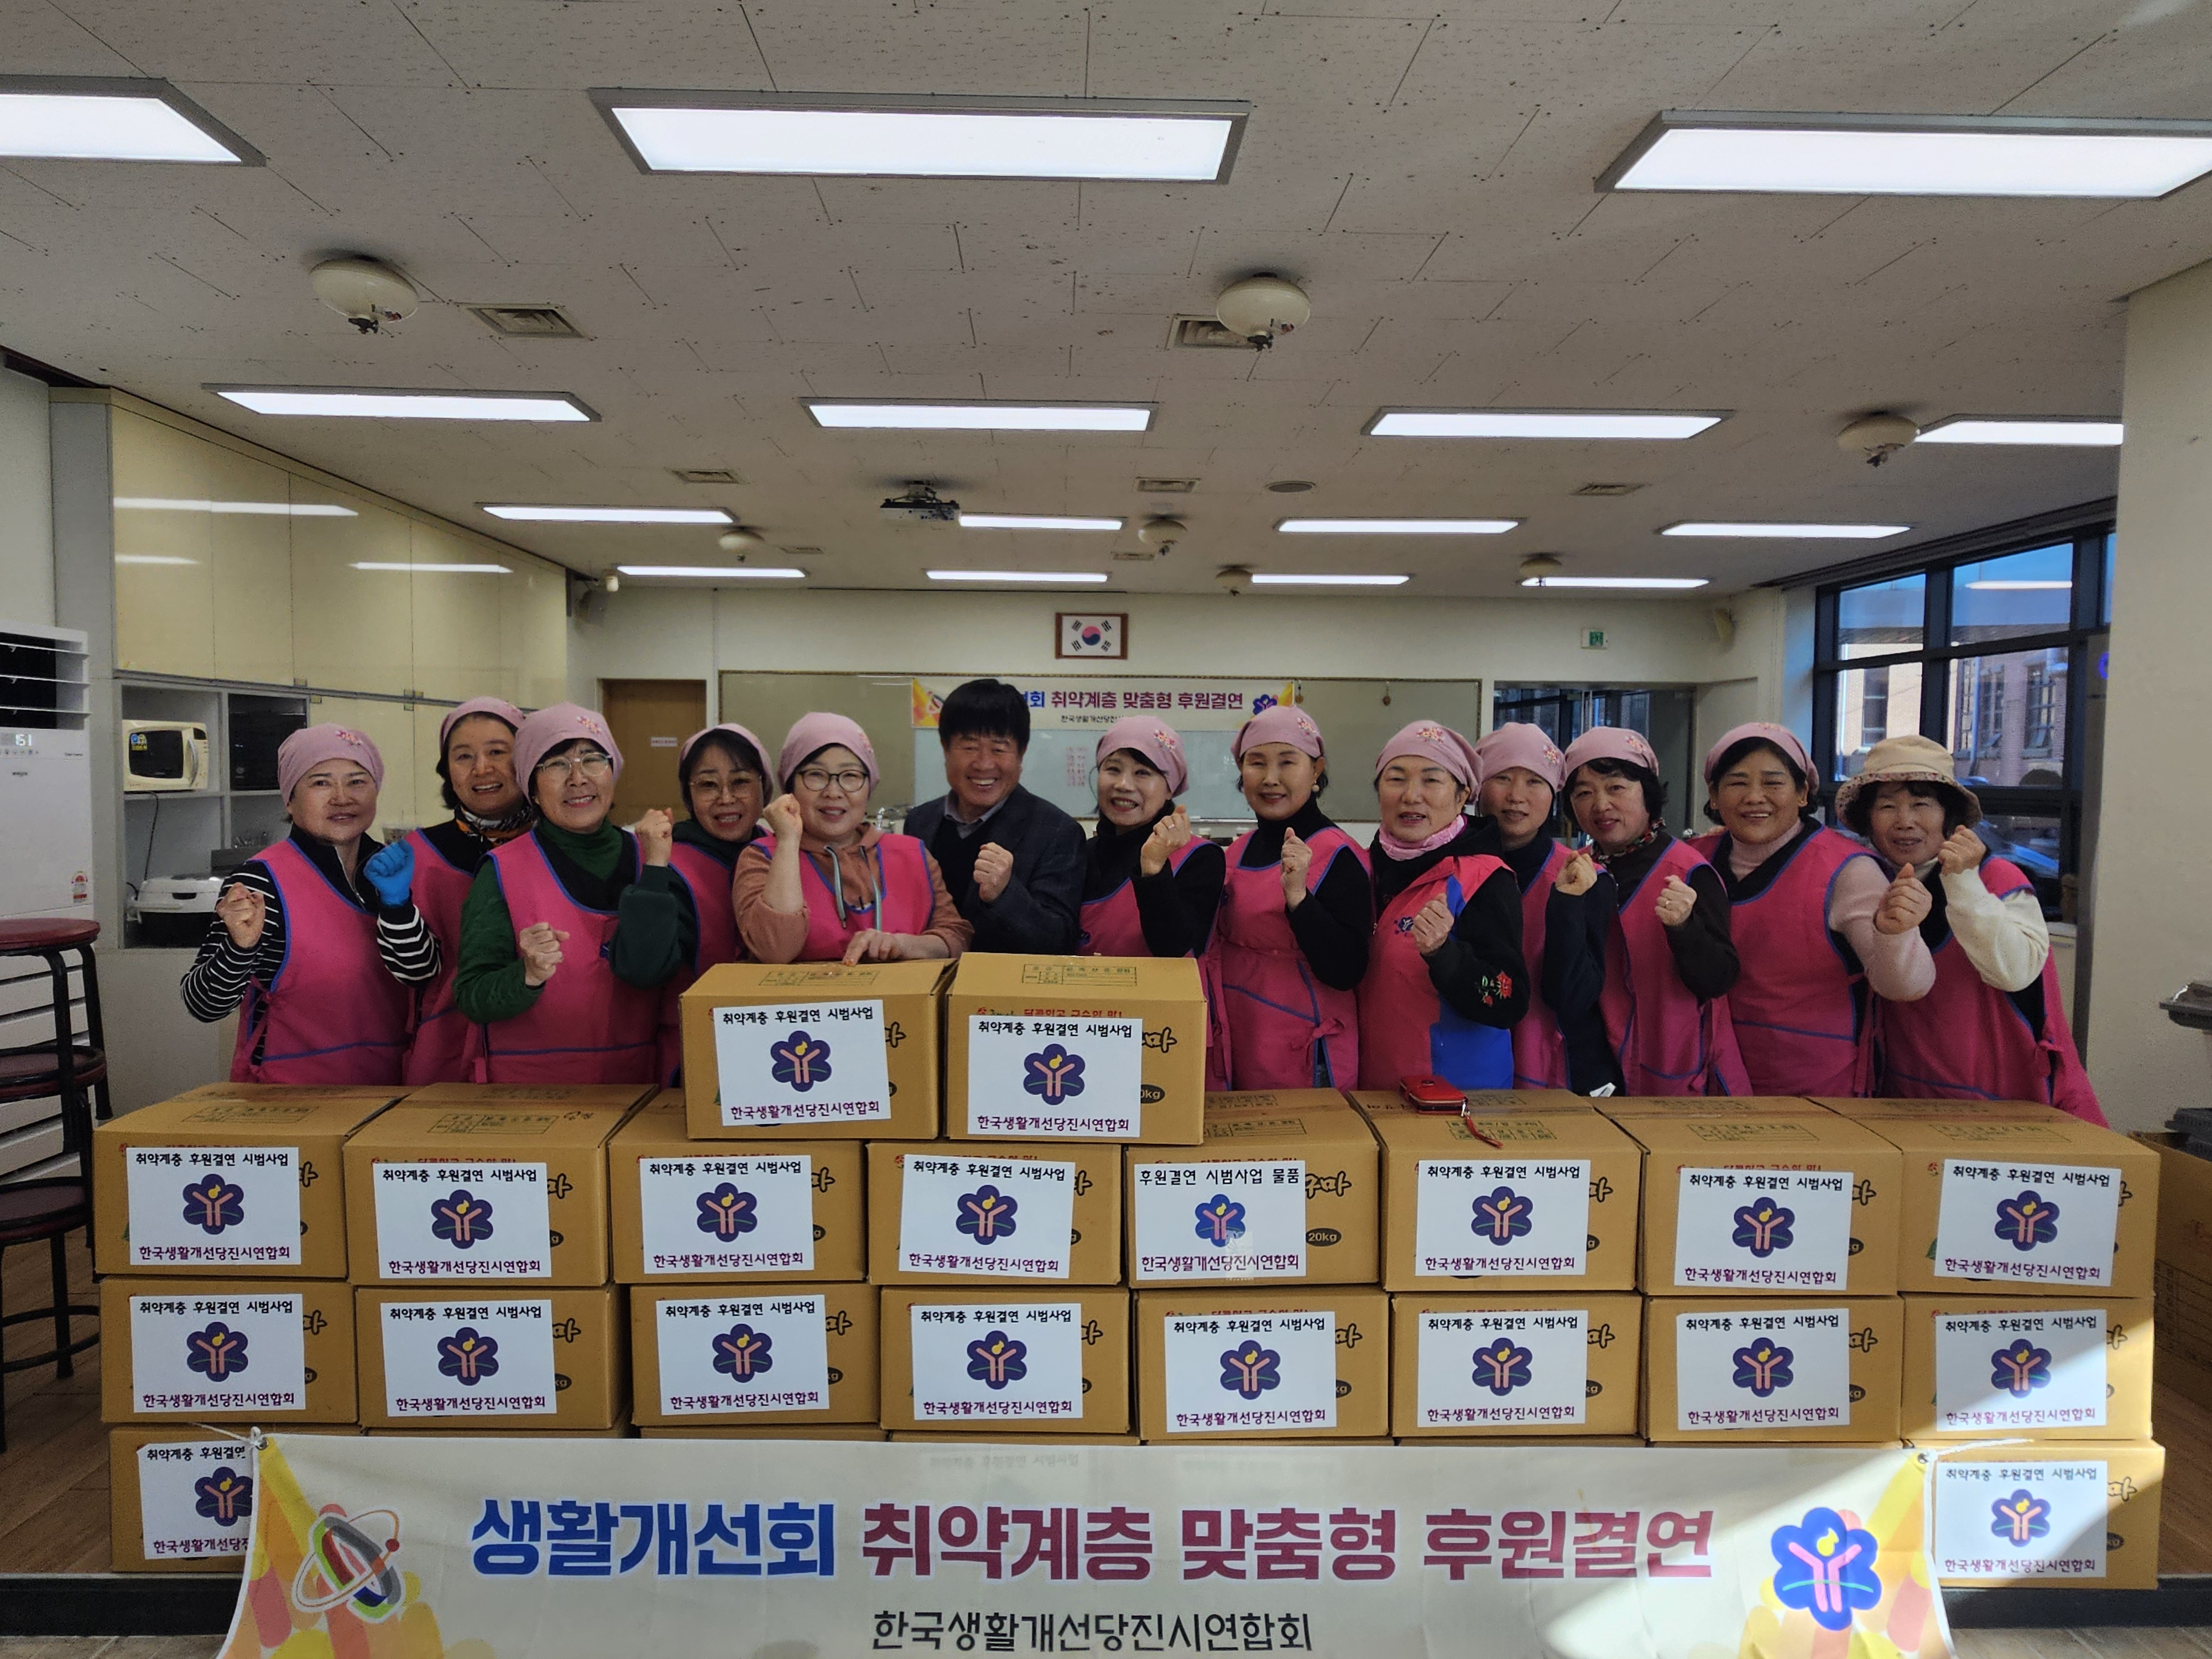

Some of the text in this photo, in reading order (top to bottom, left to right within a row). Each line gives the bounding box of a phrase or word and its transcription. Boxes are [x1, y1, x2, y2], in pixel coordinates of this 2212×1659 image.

[1052, 691, 1117, 709] 취약계층
[1123, 691, 1172, 709] 맞춤형
[1177, 691, 1243, 709] 후원결연
[723, 1007, 873, 1025] 취약계층 후원결연 시범사업
[979, 1021, 1131, 1038] 취약계층 후원결연 시범사업
[731, 1101, 879, 1120] 한국생활개선당진시연합회
[977, 1115, 1129, 1132] 한국생활개선당진시연합회
[136, 1153, 288, 1167] 취약계층 후원결연 시범사업
[383, 1170, 536, 1182] 취약계층 후원결연 시범사업
[650, 1161, 801, 1176] 취약계층 후원결연 시범사업
[914, 1161, 1065, 1181] 취약계층 후원결연 시범사업
[1428, 1166, 1579, 1179] 취약계층 후원결연 시범사업
[1953, 1166, 2109, 1187] 취약계층 후원결연 시범사업
[1140, 1168, 1299, 1186] 후원결연 시범사업 물품
[1690, 1175, 1842, 1191] 취약계층 후원결연 시범사업
[1308, 1233, 1337, 1242] 20kg
[139, 1246, 289, 1260] 한국생활개선당진시연합회
[653, 1253, 802, 1268] 한국생활개선당진시연합회
[388, 1260, 540, 1274] 한국생활개선당진시연합회
[909, 1253, 1058, 1272] 한국생활개선당진시연합회
[1142, 1255, 1298, 1272] 한국생활개선당진시연합회
[1425, 1257, 1574, 1271] 한국생활개선당진시연합회
[1944, 1258, 2100, 1280] 한국생활개선당진시연합회
[1685, 1267, 1836, 1285] 한국생활개선당진시연합회
[140, 1301, 292, 1314] 취약계층 후원결연 시범사업
[390, 1306, 541, 1321] 취약계층 후원결연 시범사업
[666, 1301, 815, 1318] 취약계층 후원결연 시범사업
[921, 1310, 1071, 1323] 취약계층 후원결연 시범사업
[1428, 1317, 1577, 1331] 취약계층 후원결연 시범사업
[1687, 1315, 1838, 1331] 취약계층 후원결연 시범사업
[1946, 1316, 2096, 1333] 취약계층 후원결연 시범사업
[1175, 1318, 1324, 1334] 취약계층 후원결연 시범사업
[143, 1392, 294, 1408] 한국생활개선당진시연합회
[396, 1396, 545, 1411] 한국생활개선당진시연합회
[670, 1392, 818, 1410] 한국생활개선당진시연합회
[924, 1401, 1071, 1415] 한국생활개선당진시연합회
[1176, 1410, 1325, 1427] 한국생활개선당진시연합회
[1427, 1406, 1574, 1422] 한국생활개선당진시연합회
[1688, 1407, 1838, 1425] 한국생활개선당진시연합회
[1946, 1408, 2095, 1425] 한국생활개선당진시연합회
[147, 1448, 194, 1462] 취약계층
[1946, 1468, 2096, 1481] 취약계층 후원결연 시범사업
[472, 1499, 1715, 1581] 생활개선회 취약계층 맞춤형 후원결연
[1945, 1559, 2095, 1573] 한국생활개선당진시연합회
[874, 1610, 1313, 1652] 한국생활개선당진시연합회
